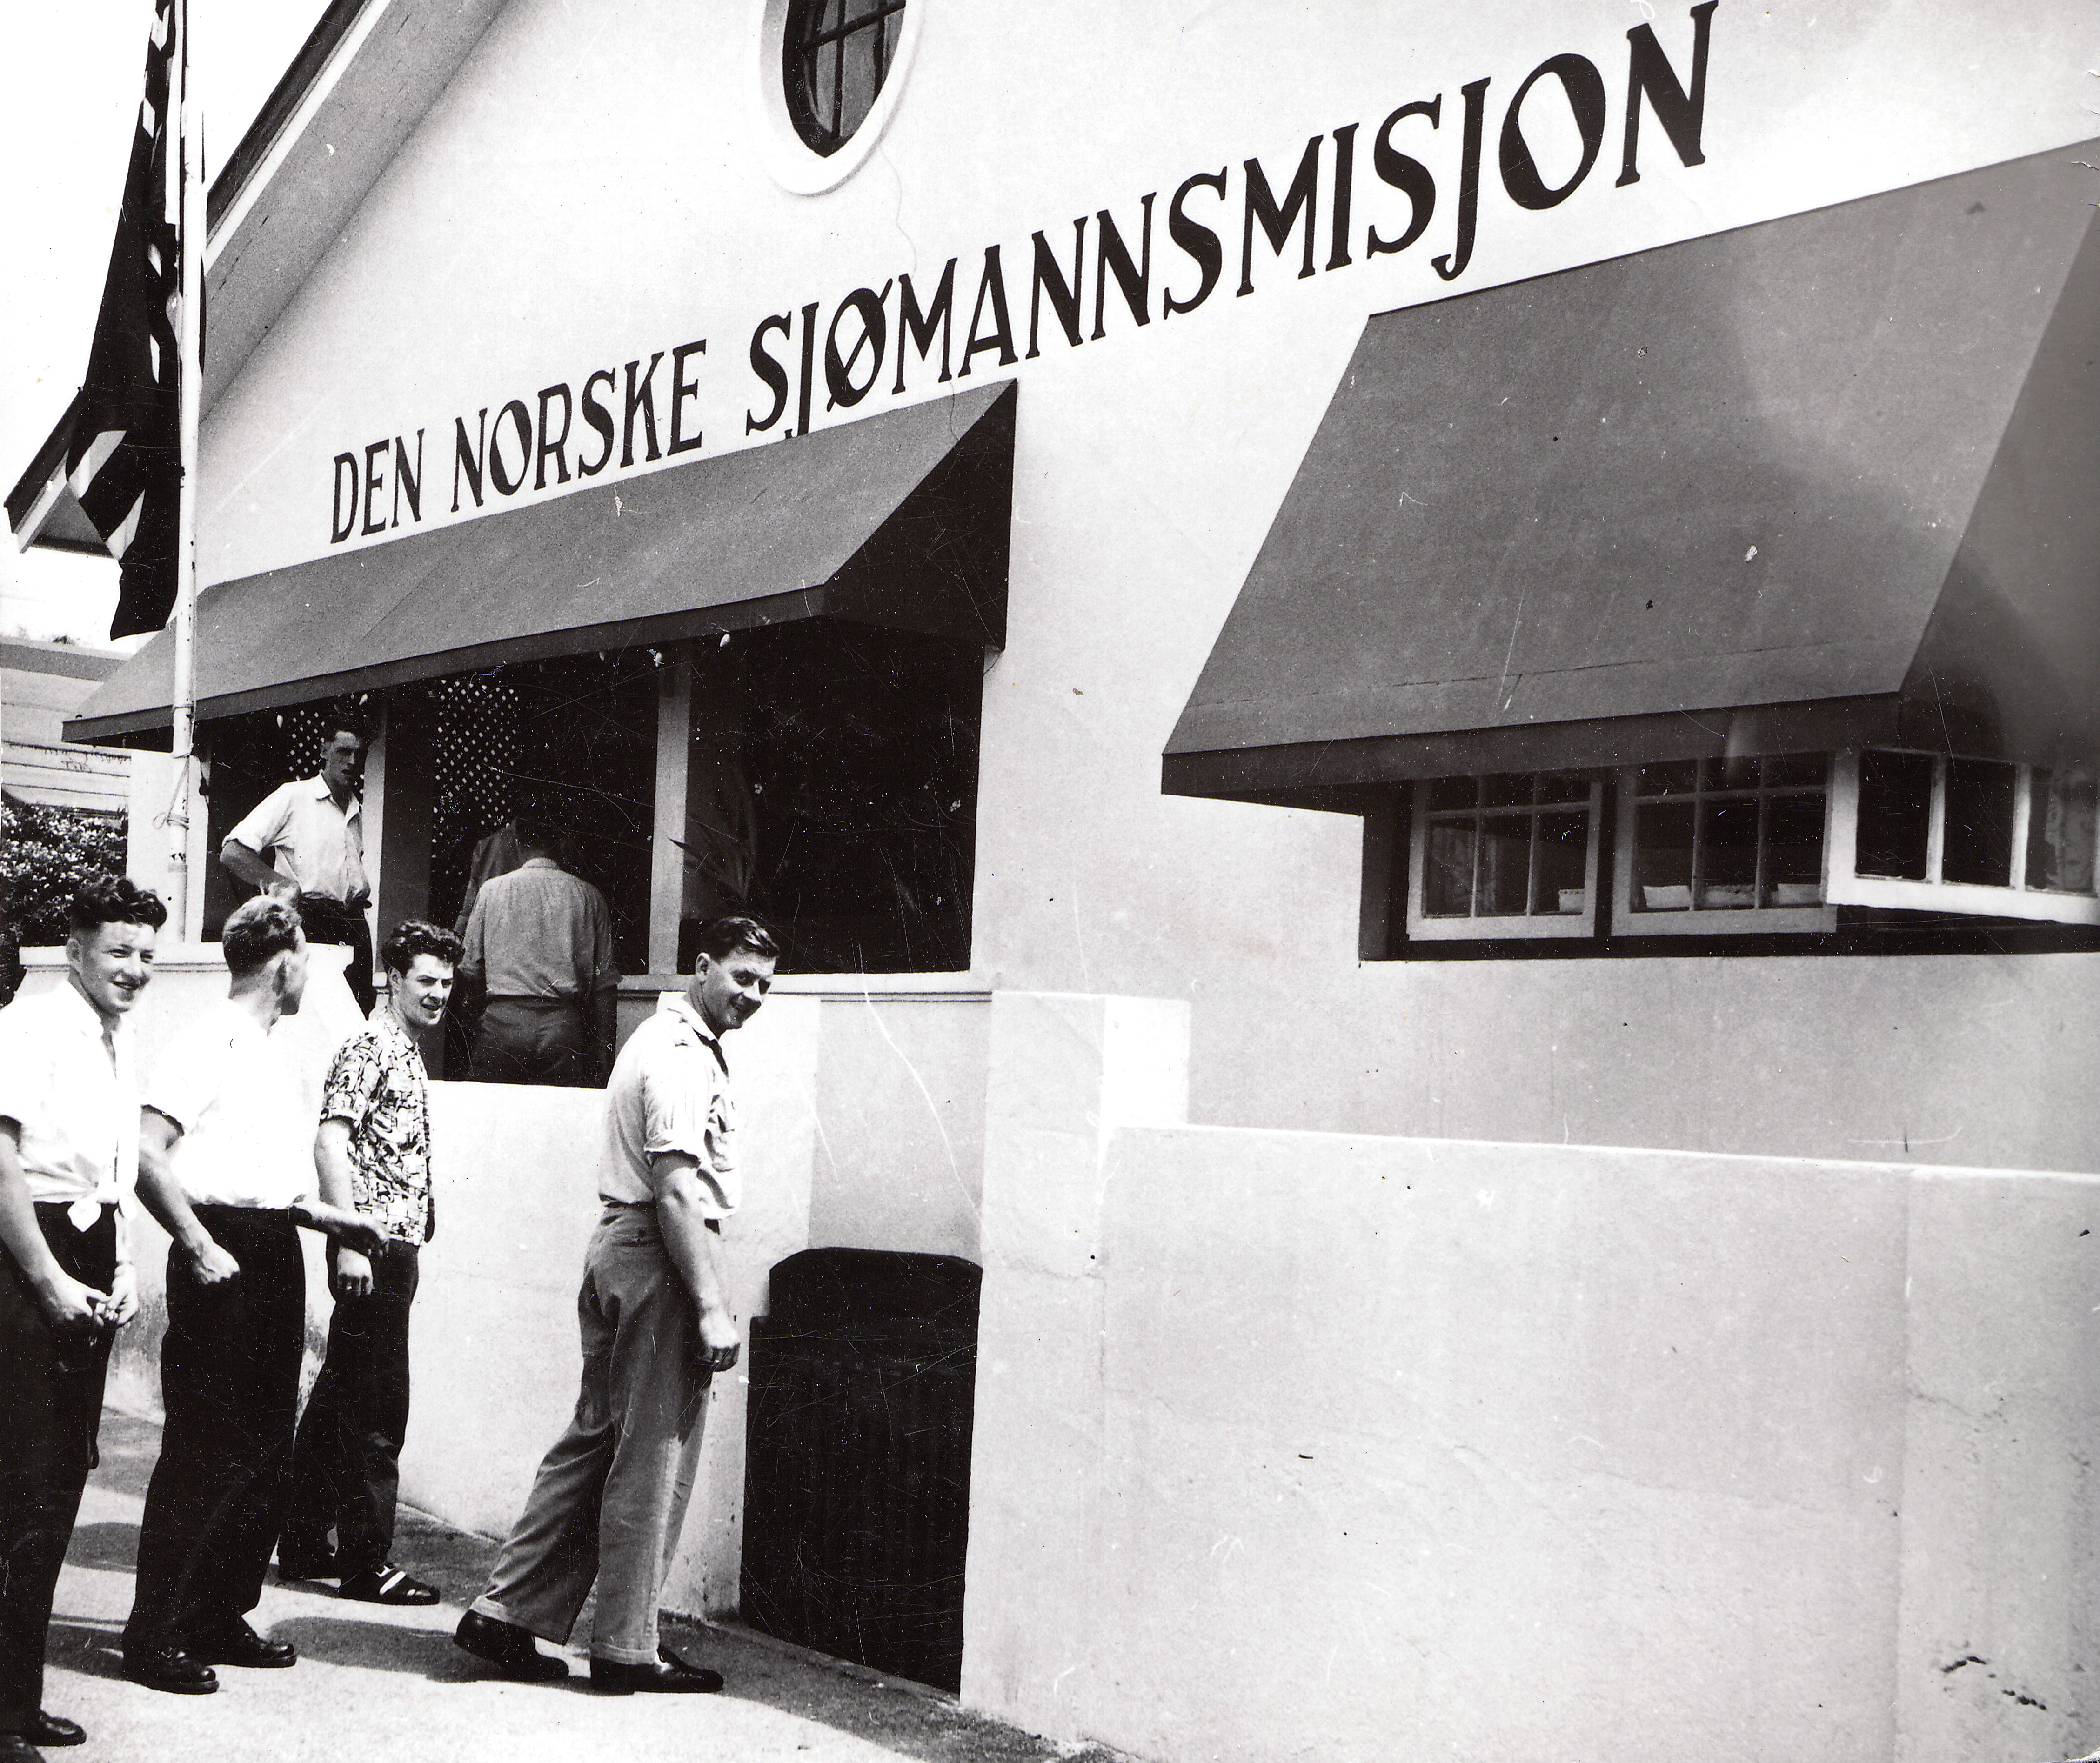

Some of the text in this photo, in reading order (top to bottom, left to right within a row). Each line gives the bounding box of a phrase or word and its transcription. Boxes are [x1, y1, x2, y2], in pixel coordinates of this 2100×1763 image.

[331, 0, 1719, 543] DEN NORSKE SJØMANNSMISJON
